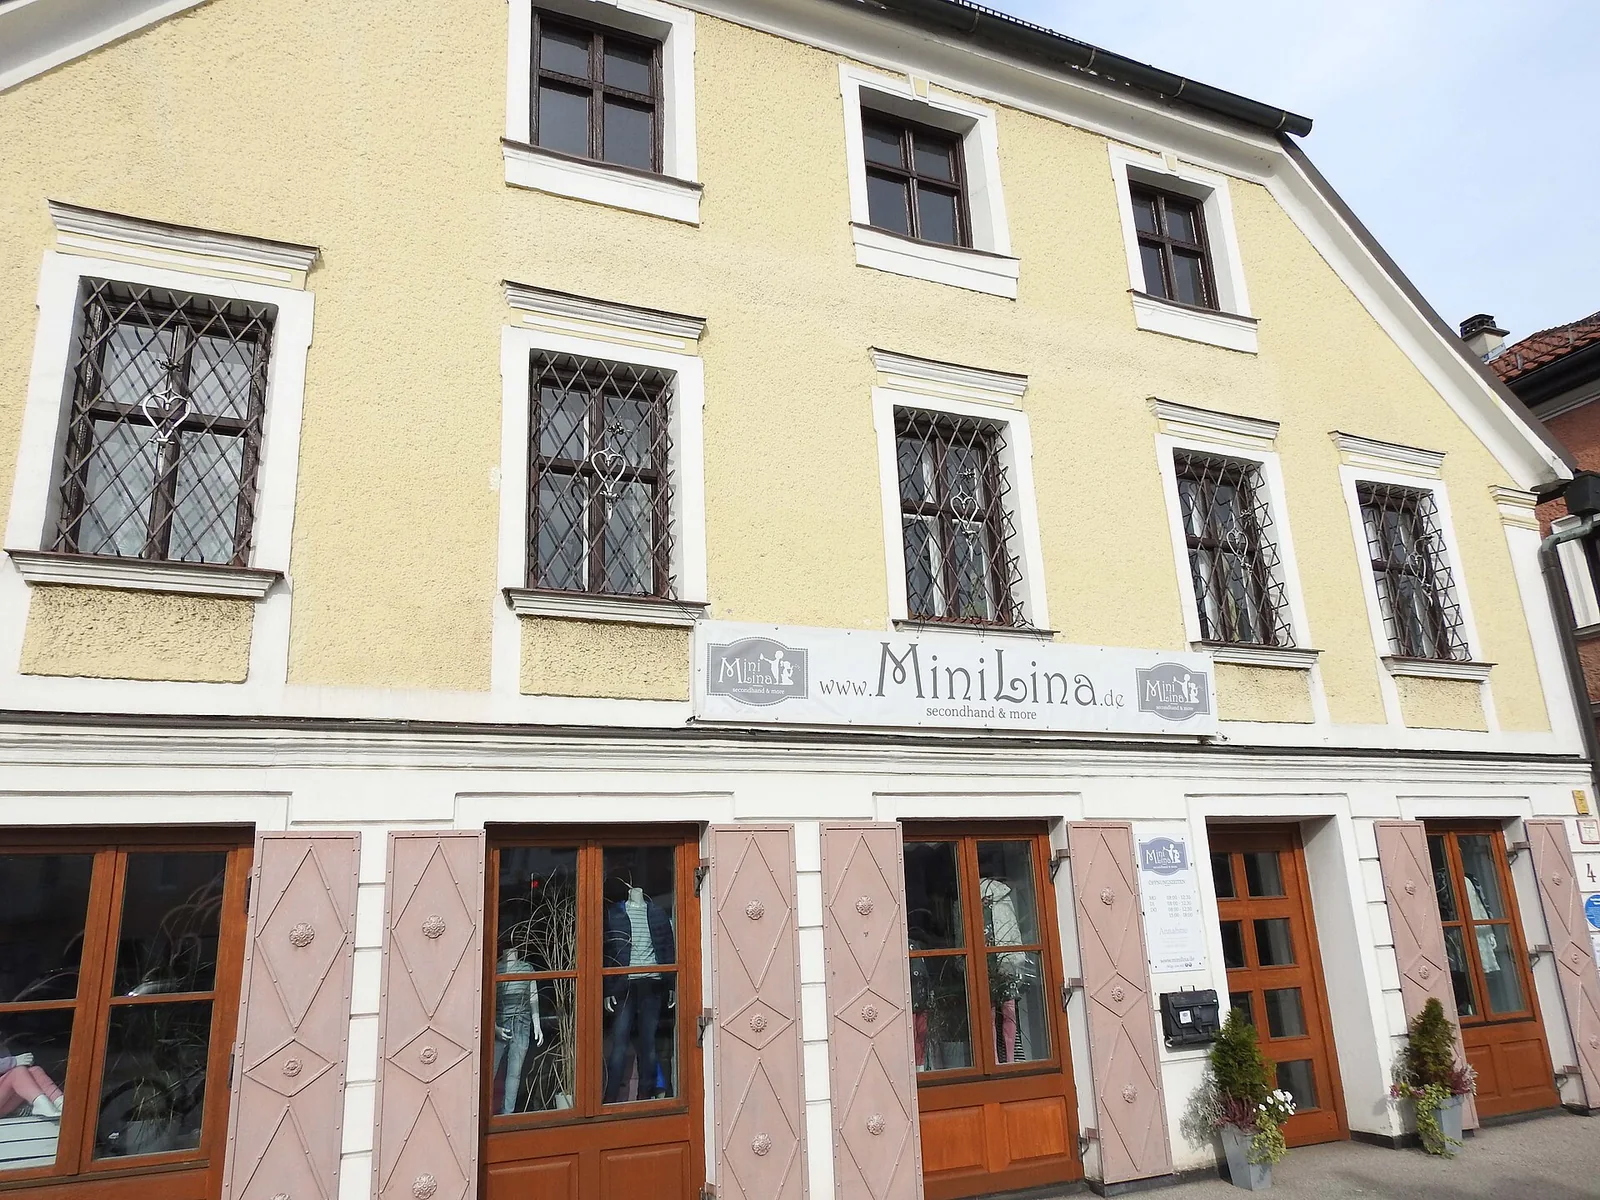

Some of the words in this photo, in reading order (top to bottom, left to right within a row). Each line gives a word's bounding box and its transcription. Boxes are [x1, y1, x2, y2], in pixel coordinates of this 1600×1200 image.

[718, 657, 761, 684] Mini
[732, 687, 765, 695] secondhand
[1145, 680, 1175, 702] Mini
[926, 705, 995, 719] secondhand
[998, 708, 1006, 719] &
[1009, 711, 1037, 720] more
[1586, 863, 1597, 883] 4
